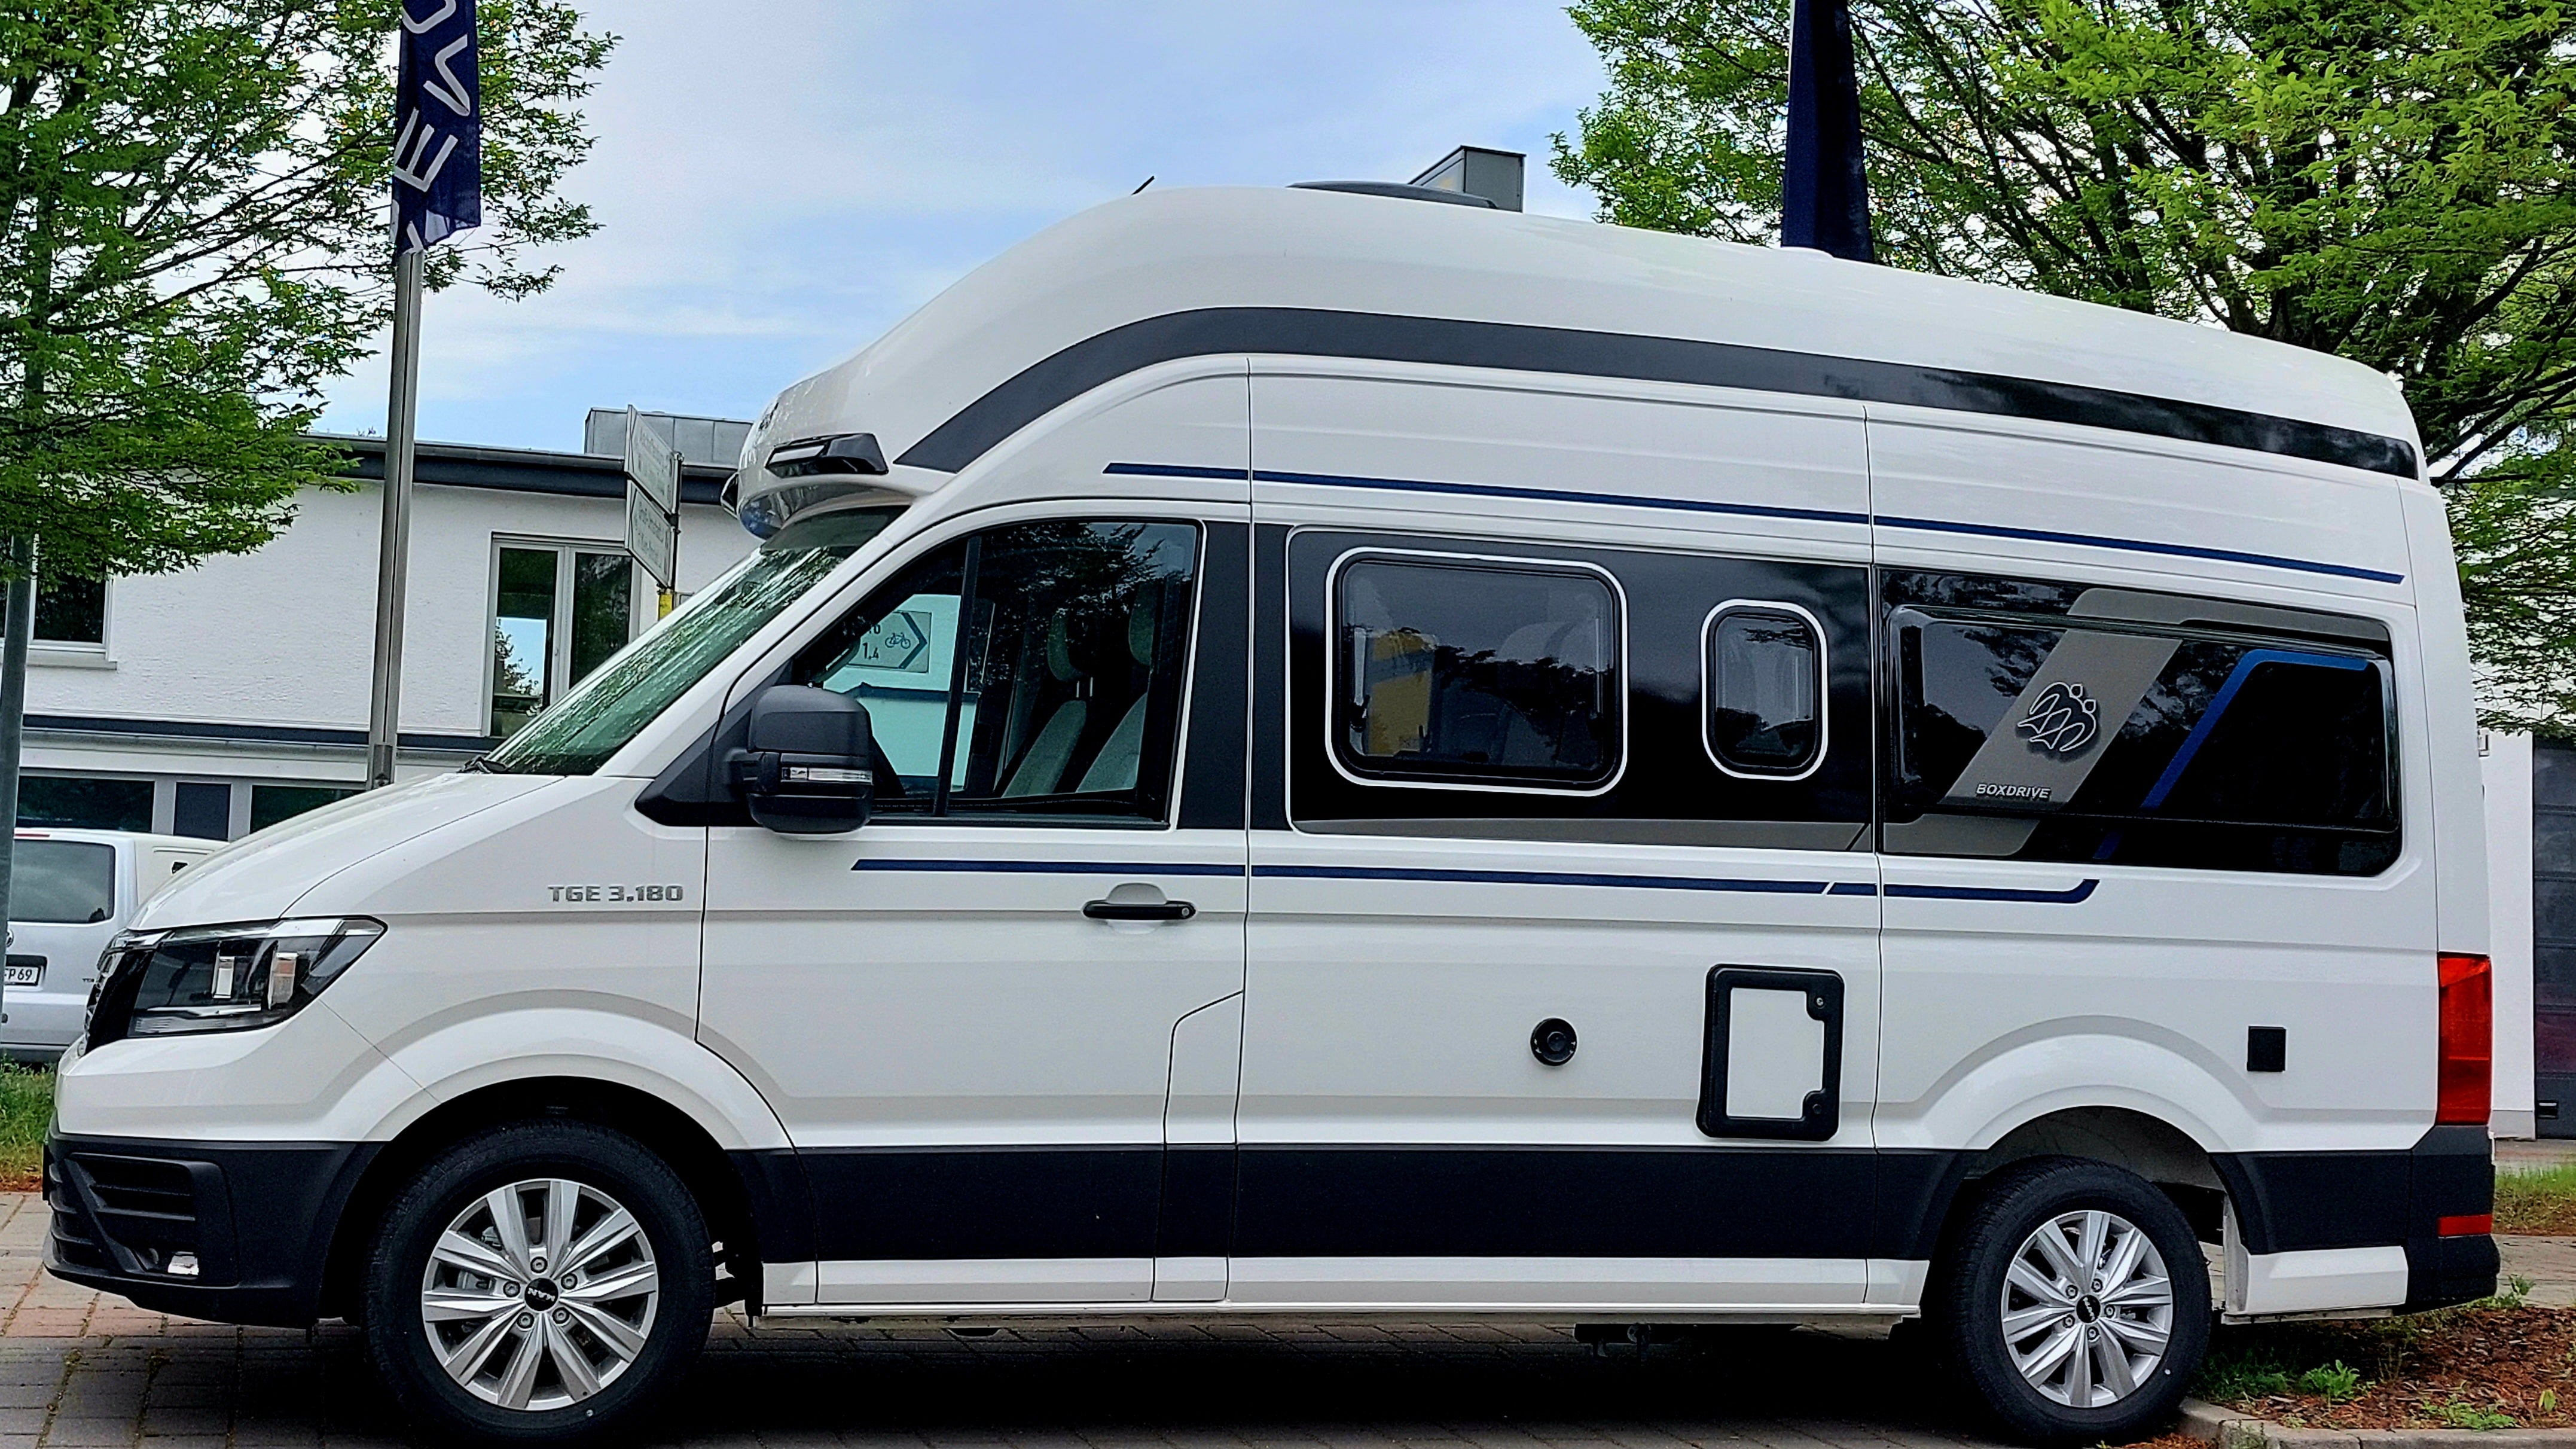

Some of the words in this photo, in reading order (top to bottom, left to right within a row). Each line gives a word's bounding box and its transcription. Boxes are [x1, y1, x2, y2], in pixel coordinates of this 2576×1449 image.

[862, 642, 879, 659] 1.4
[1976, 783, 2051, 799] BOXDRIVE
[547, 886, 600, 902] TGE
[608, 885, 683, 902] 3.180
[17, 968, 32, 981] 69
[527, 1287, 556, 1302] MAN
